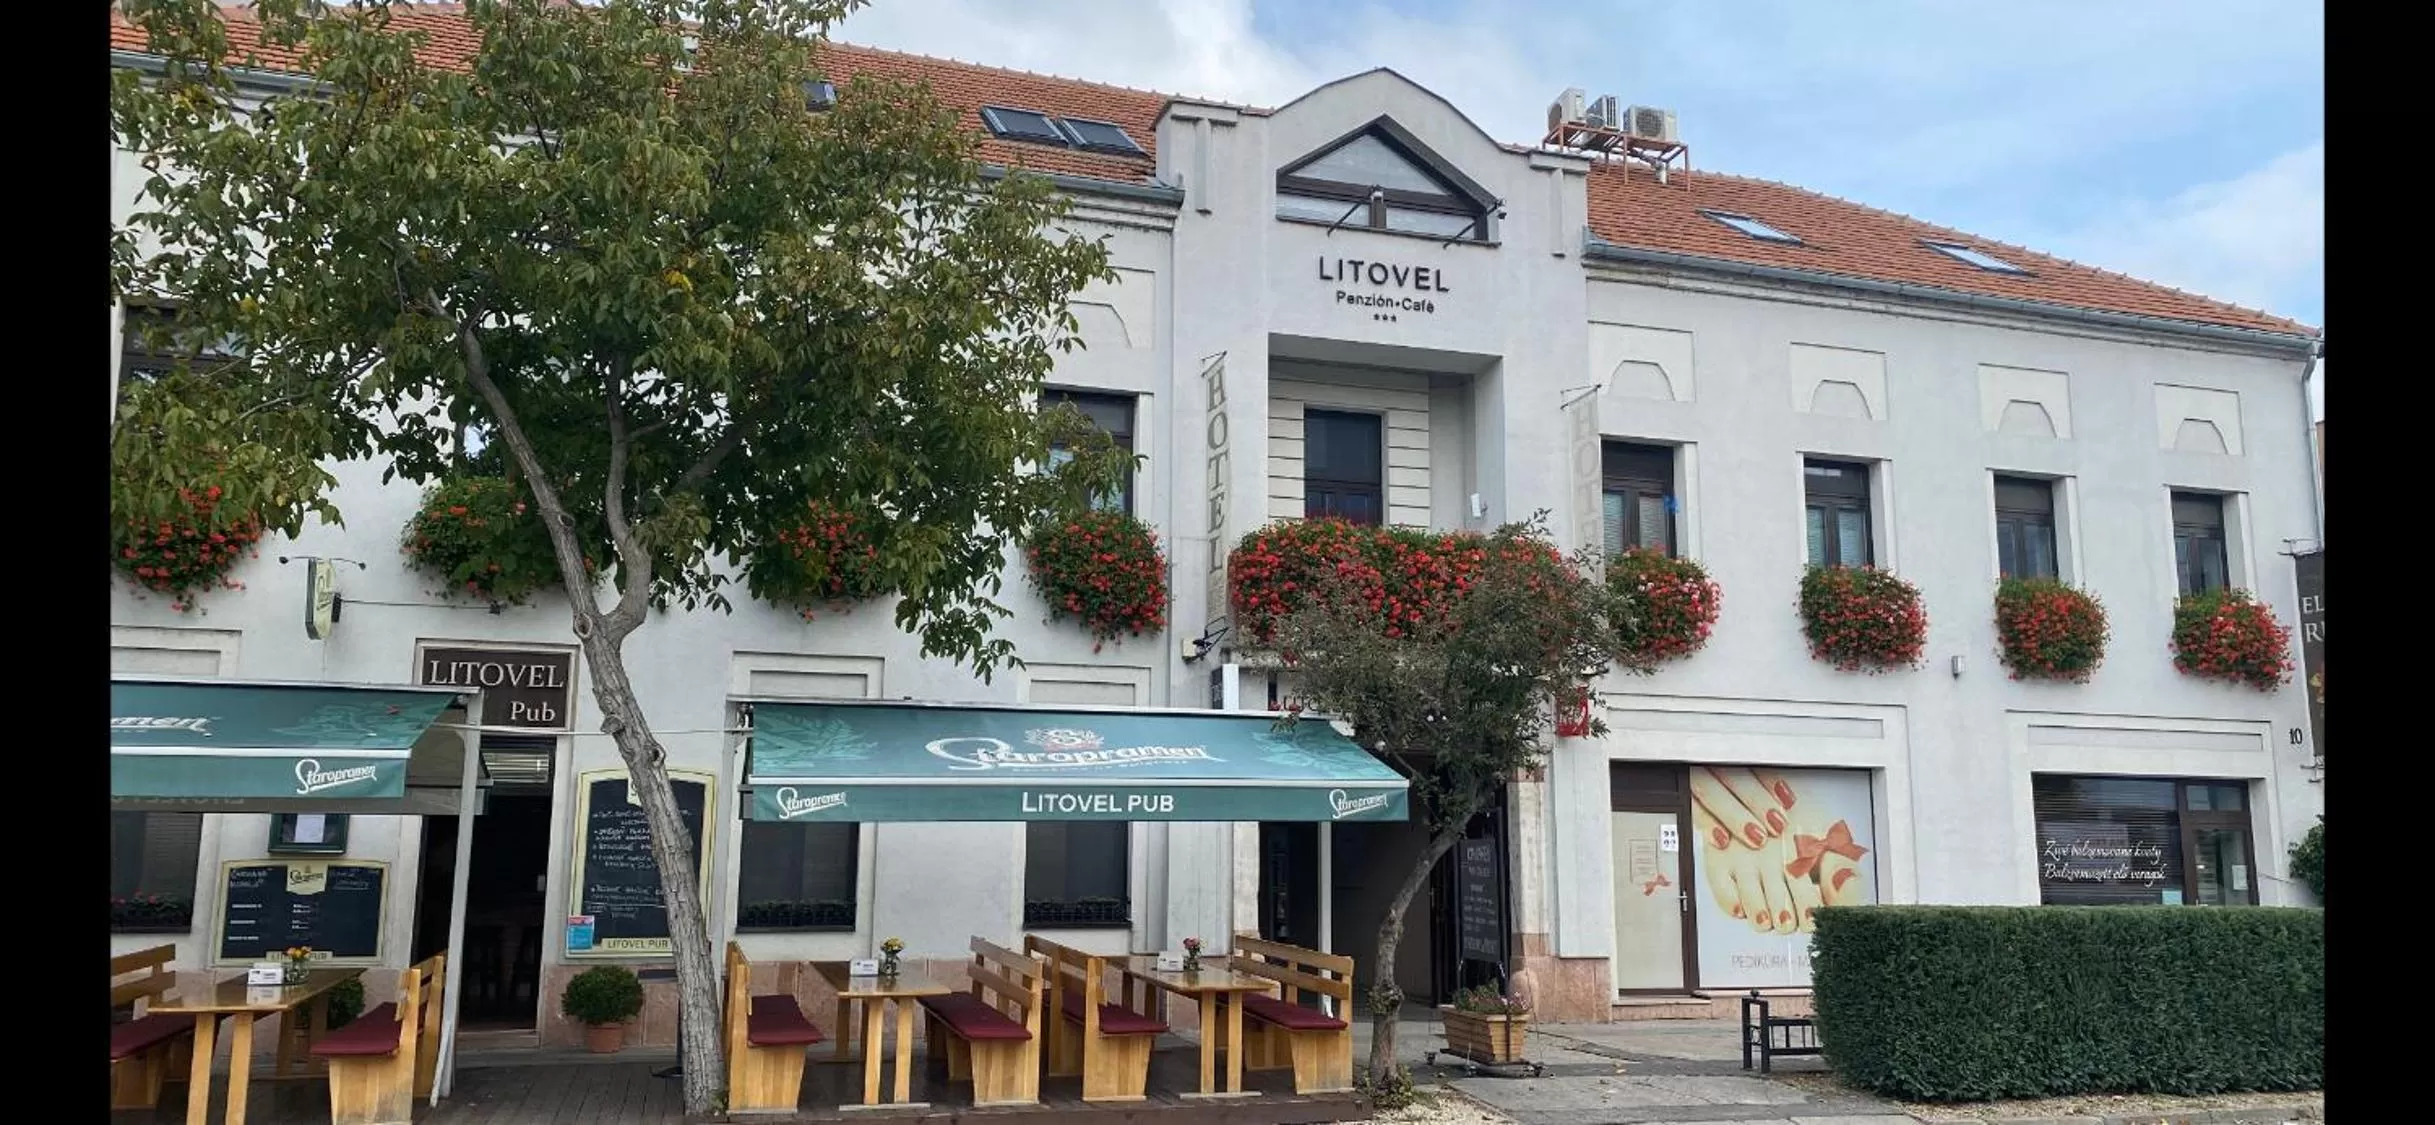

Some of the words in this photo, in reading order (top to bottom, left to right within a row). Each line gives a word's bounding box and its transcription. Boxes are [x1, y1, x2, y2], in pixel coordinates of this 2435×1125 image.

[1319, 256, 1449, 292] LITOVEL
[1207, 365, 1229, 575] HOTEL
[429, 659, 564, 689] LITOVEL
[510, 700, 556, 722] Pub
[2289, 728, 2303, 744] 10
[925, 736, 1228, 771] Staropramen
[295, 758, 377, 794] Staropramen
[776, 786, 848, 819] Staropramen
[1127, 794, 1175, 813] PUB
[1329, 789, 1389, 818] Staropramen
[607, 939, 645, 948] LITOVEL
